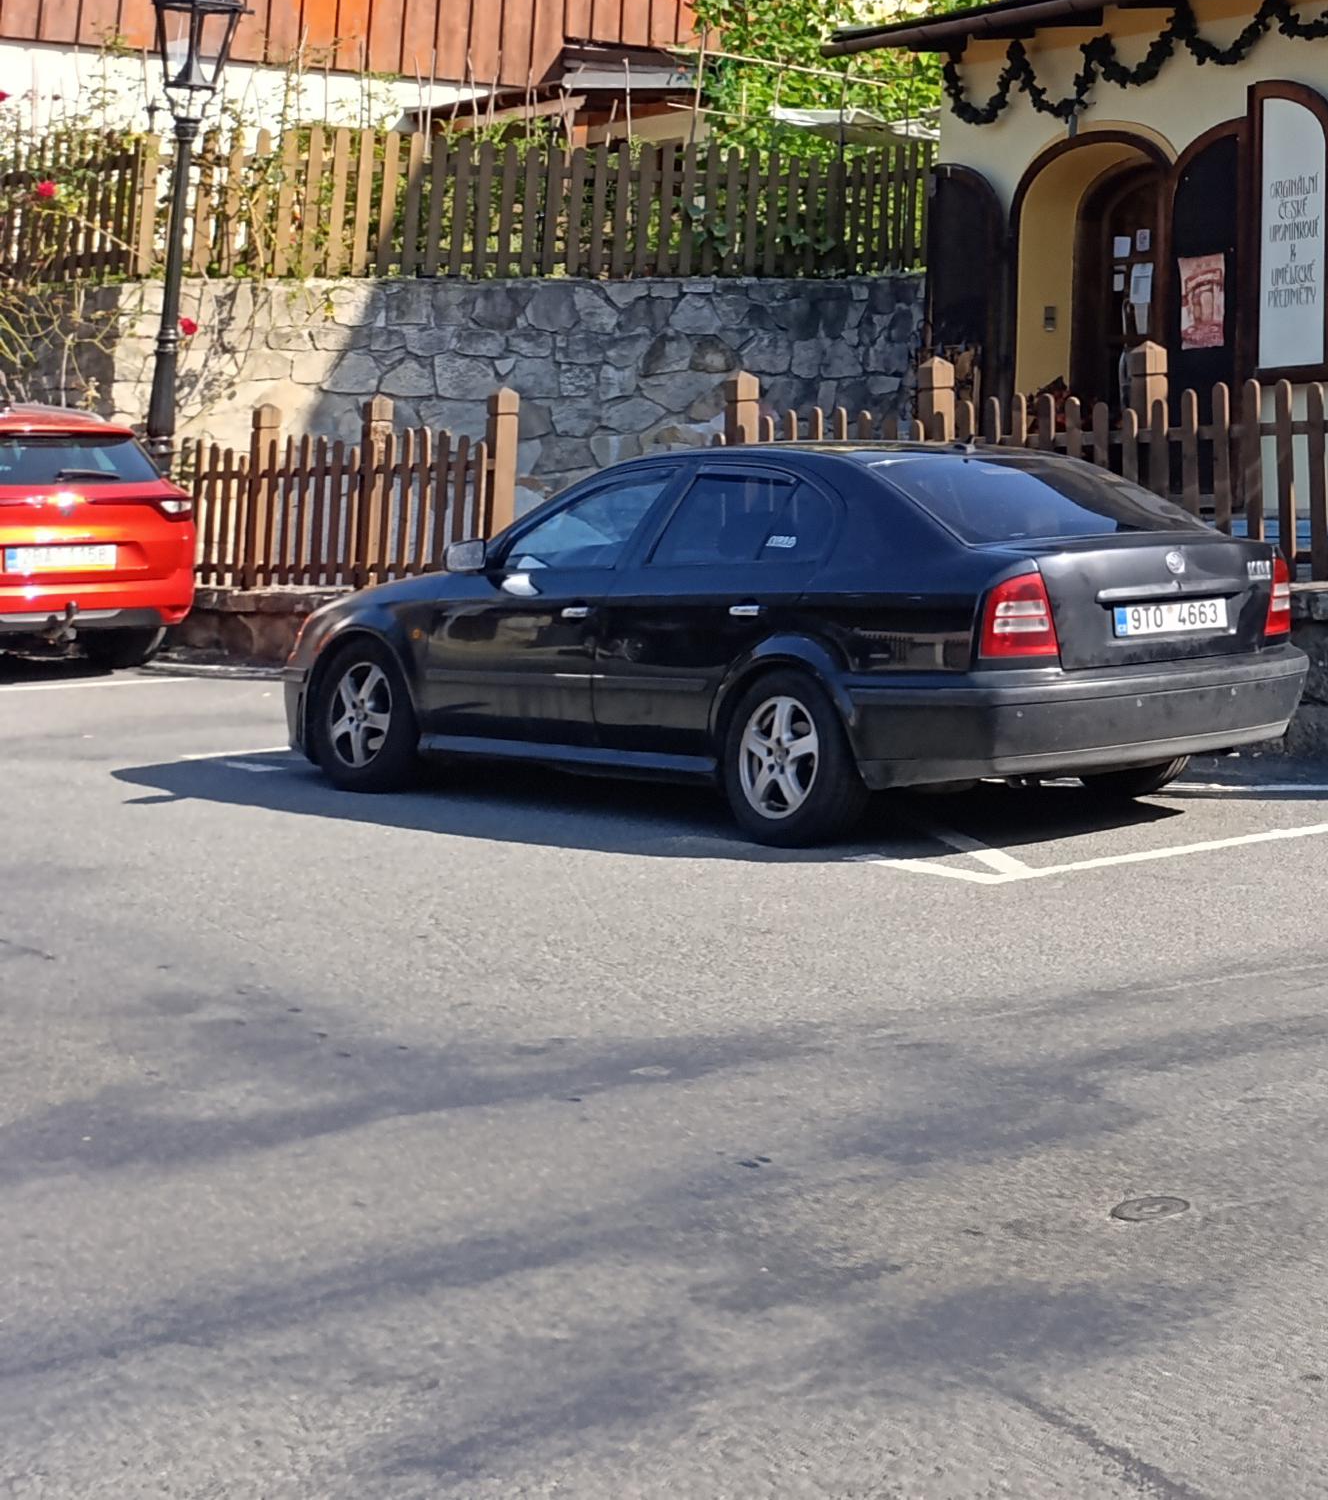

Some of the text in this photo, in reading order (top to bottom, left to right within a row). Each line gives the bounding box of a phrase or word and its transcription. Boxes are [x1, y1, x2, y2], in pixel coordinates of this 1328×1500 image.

[1270, 172, 1319, 198] ORIGINÁLNÍ
[1278, 197, 1308, 220] ČESKÉ
[1271, 260, 1316, 286] UMĚLECKÉ
[1267, 284, 1316, 308] PŘEDMĚTY
[1178, 602, 1218, 626] 4663
